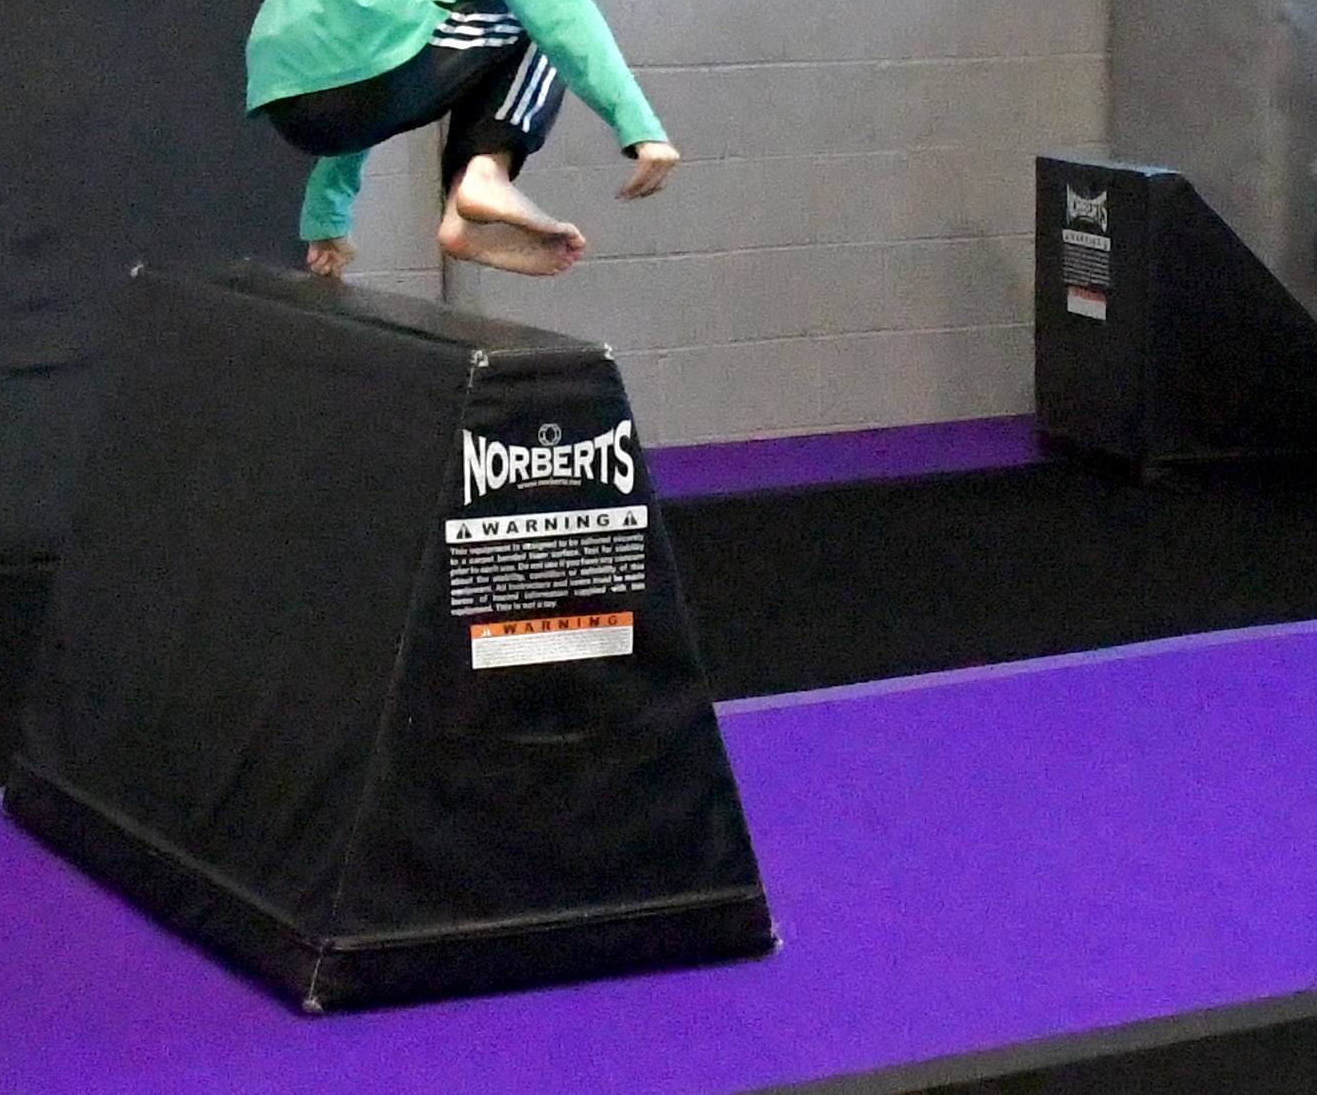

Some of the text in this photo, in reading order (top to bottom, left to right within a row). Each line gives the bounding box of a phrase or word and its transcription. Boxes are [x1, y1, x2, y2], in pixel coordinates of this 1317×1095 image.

[462, 419, 635, 506] NORBERTS
[482, 513, 610, 536] WARNING
[502, 617, 618, 635] WARNING
